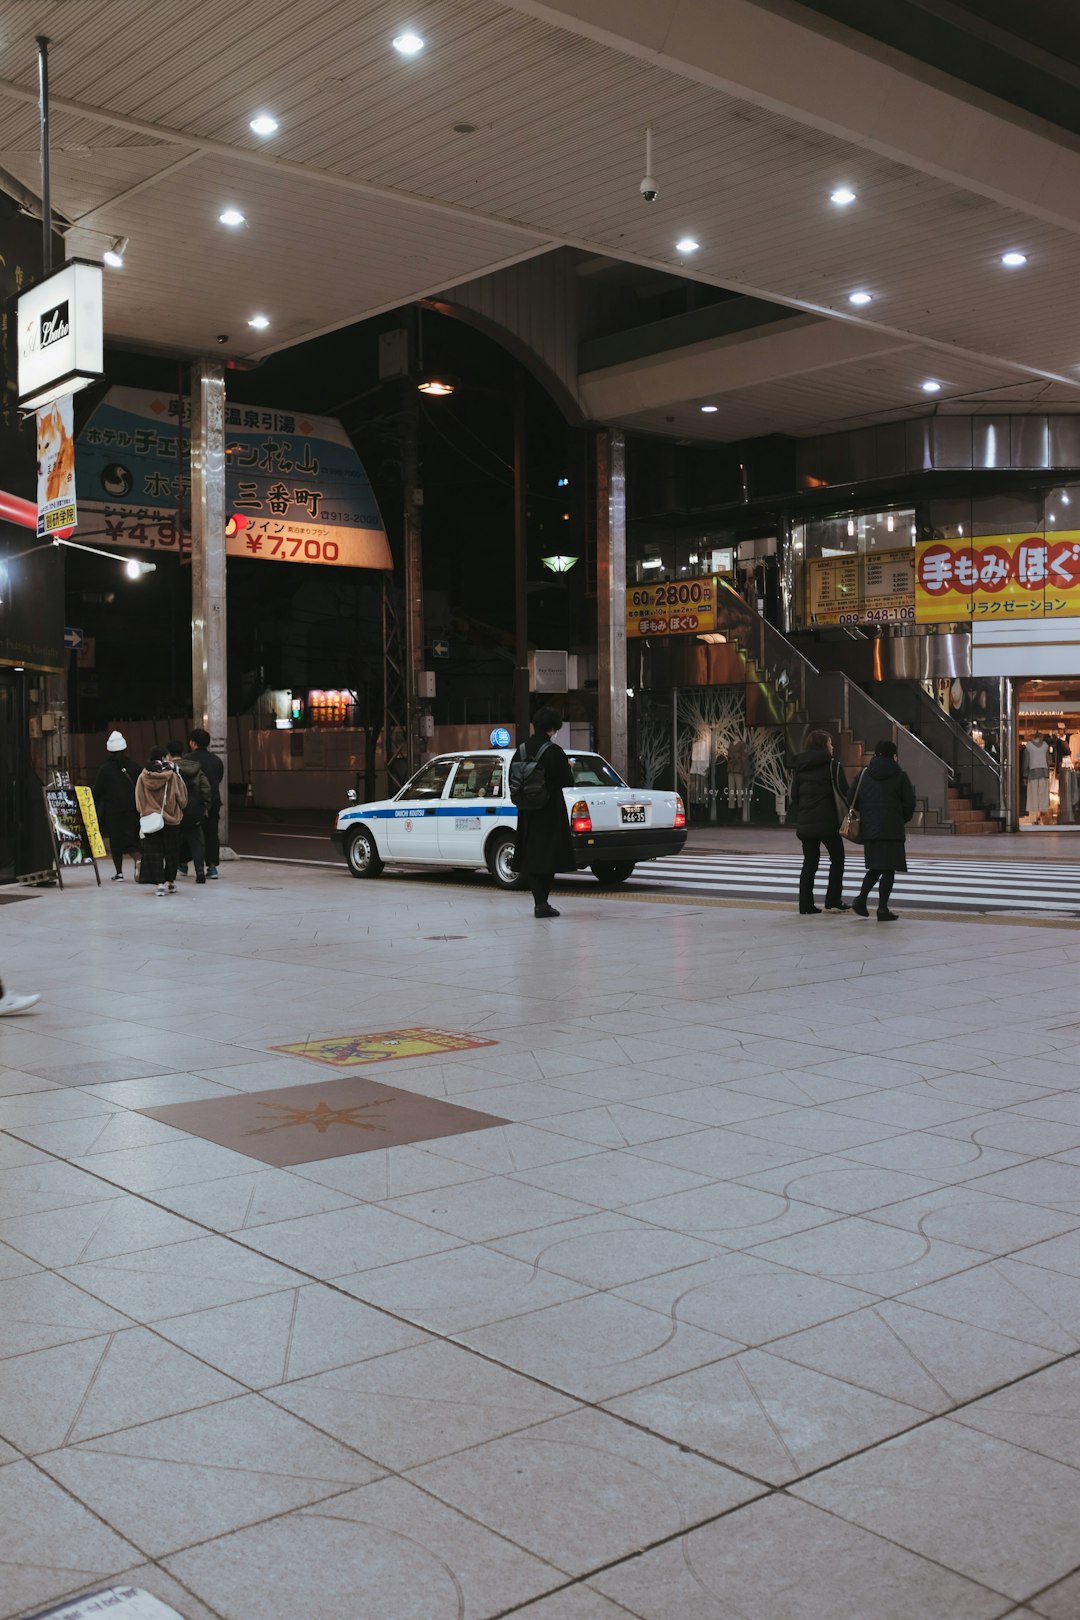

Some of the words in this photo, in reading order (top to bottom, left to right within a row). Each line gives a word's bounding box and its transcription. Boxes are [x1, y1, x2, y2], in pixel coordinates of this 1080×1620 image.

[330, 511, 379, 525] 913-2000
[245, 533, 339, 561] ¥7,700
[922, 552, 1007, 590] 手もみ
[966, 598, 1067, 617] リラクゼーション
[639, 620, 667, 634] 手もみ
[670, 617, 698, 630] ほぐし
[626, 812, 645, 822] 66-35
